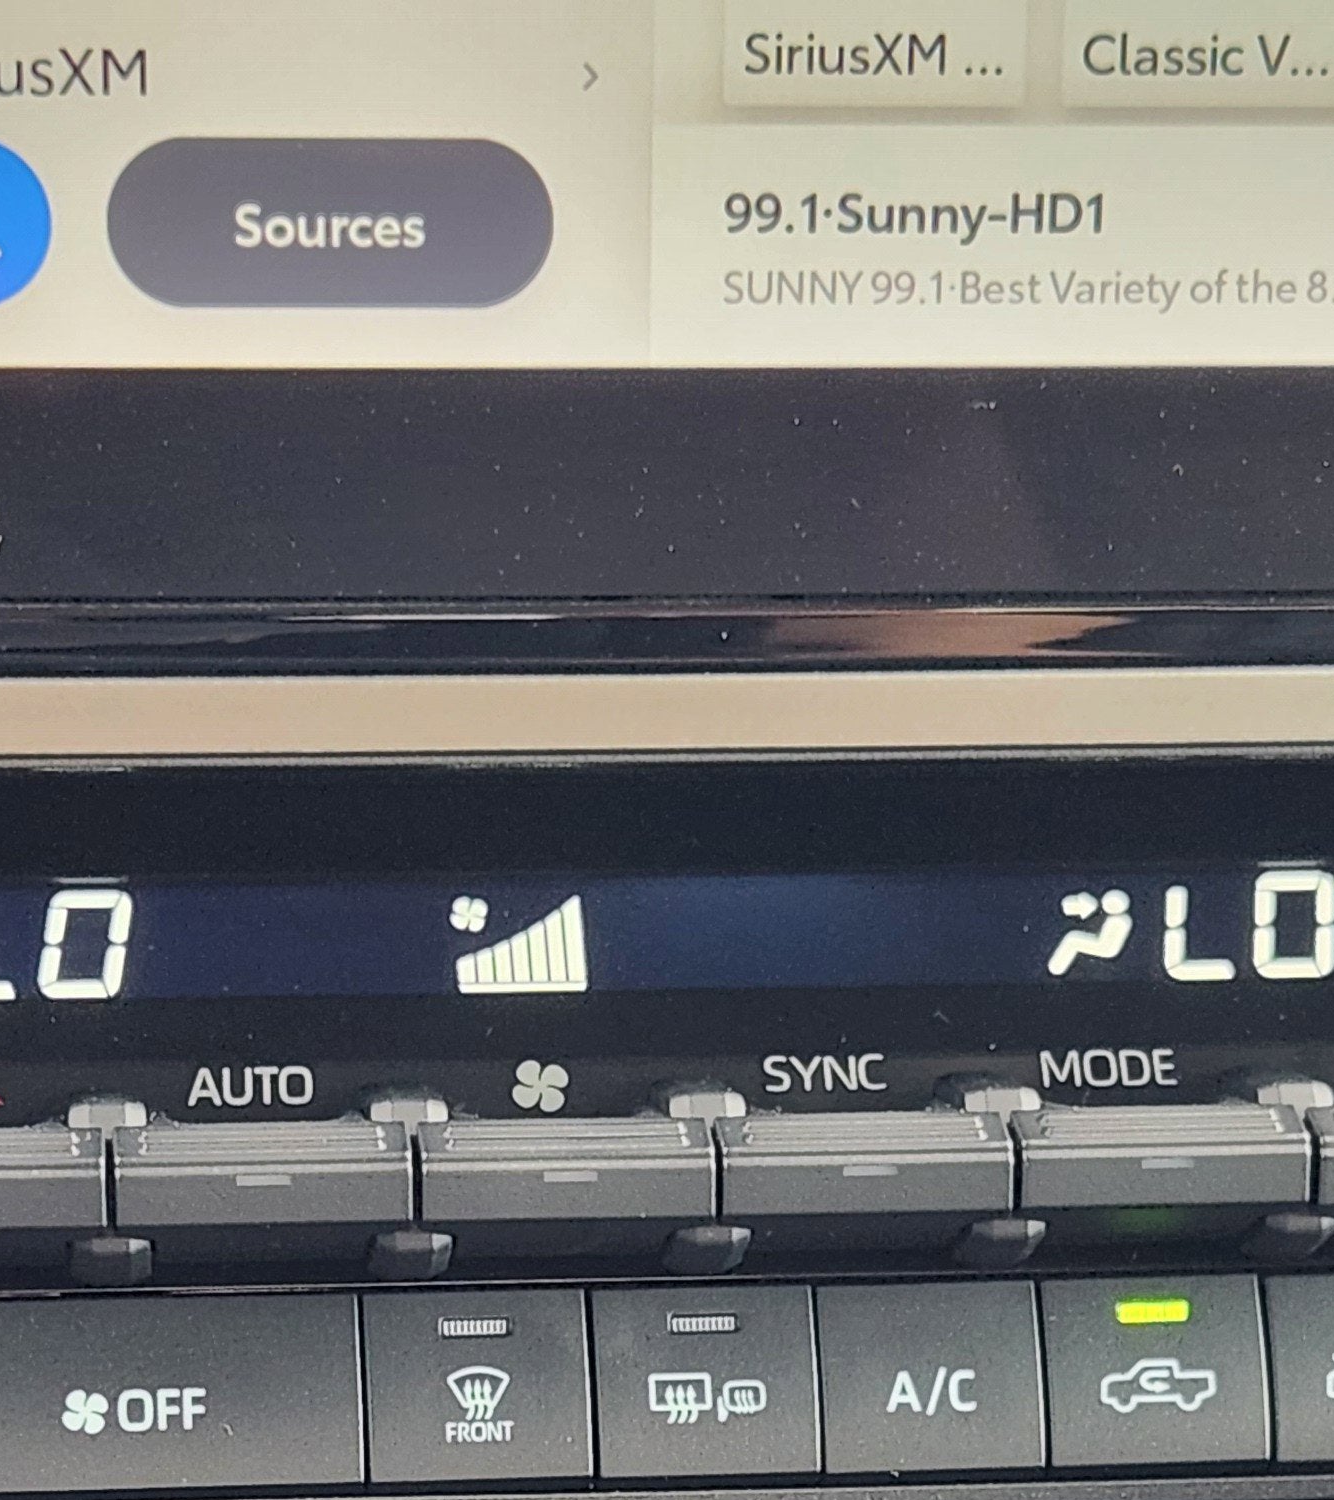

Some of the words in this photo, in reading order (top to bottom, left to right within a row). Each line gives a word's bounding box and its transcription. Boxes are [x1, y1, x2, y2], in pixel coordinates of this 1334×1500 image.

[743, 33, 948, 77] SiriusXM
[1082, 33, 1245, 77] Classic
[233, 202, 426, 249] Sources
[723, 271, 864, 306] SUNNY
[1050, 270, 1182, 314] Variety
[1188, 269, 1231, 305] of
[1234, 270, 1298, 305] the
[186, 1065, 315, 1107] AUTO
[761, 1052, 888, 1093] SYNC
[1039, 1047, 1178, 1089] MODE
[116, 1386, 207, 1434] OFF
[885, 1365, 978, 1415] A/C
[444, 1420, 514, 1443] FRONT
